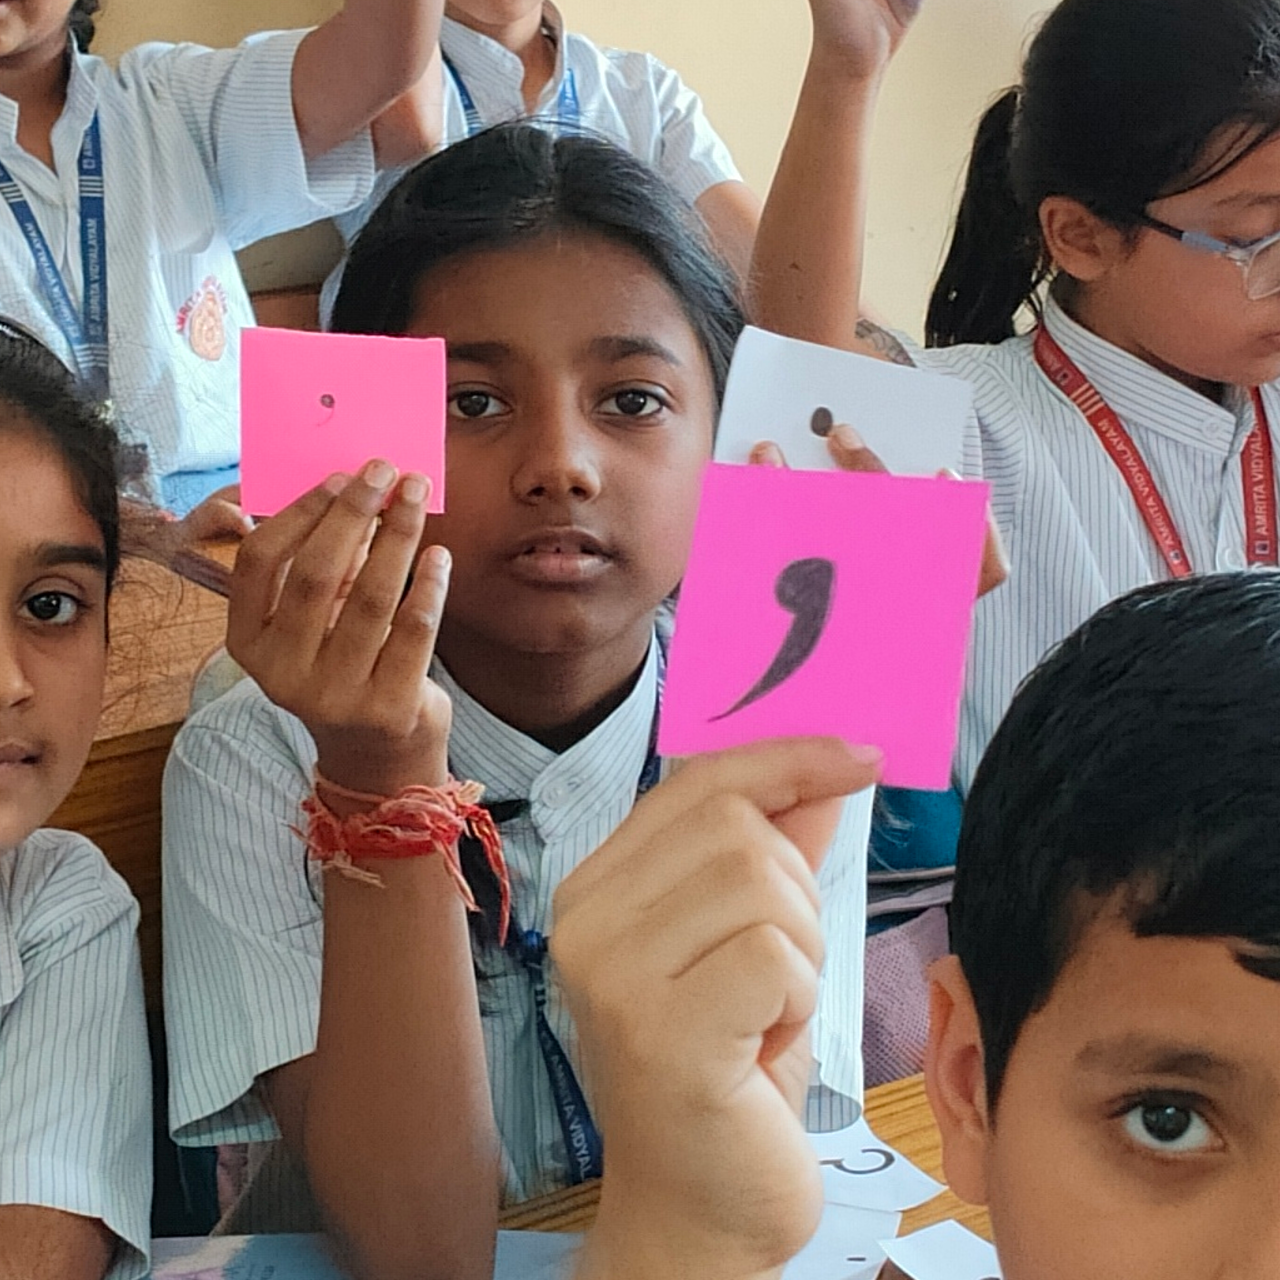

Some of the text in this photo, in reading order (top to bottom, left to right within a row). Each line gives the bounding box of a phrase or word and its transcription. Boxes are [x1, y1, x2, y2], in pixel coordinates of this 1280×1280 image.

[1097, 418, 1177, 547] AMRITA VIDYALAYAM
[1254, 486, 1269, 537] AMRITA
